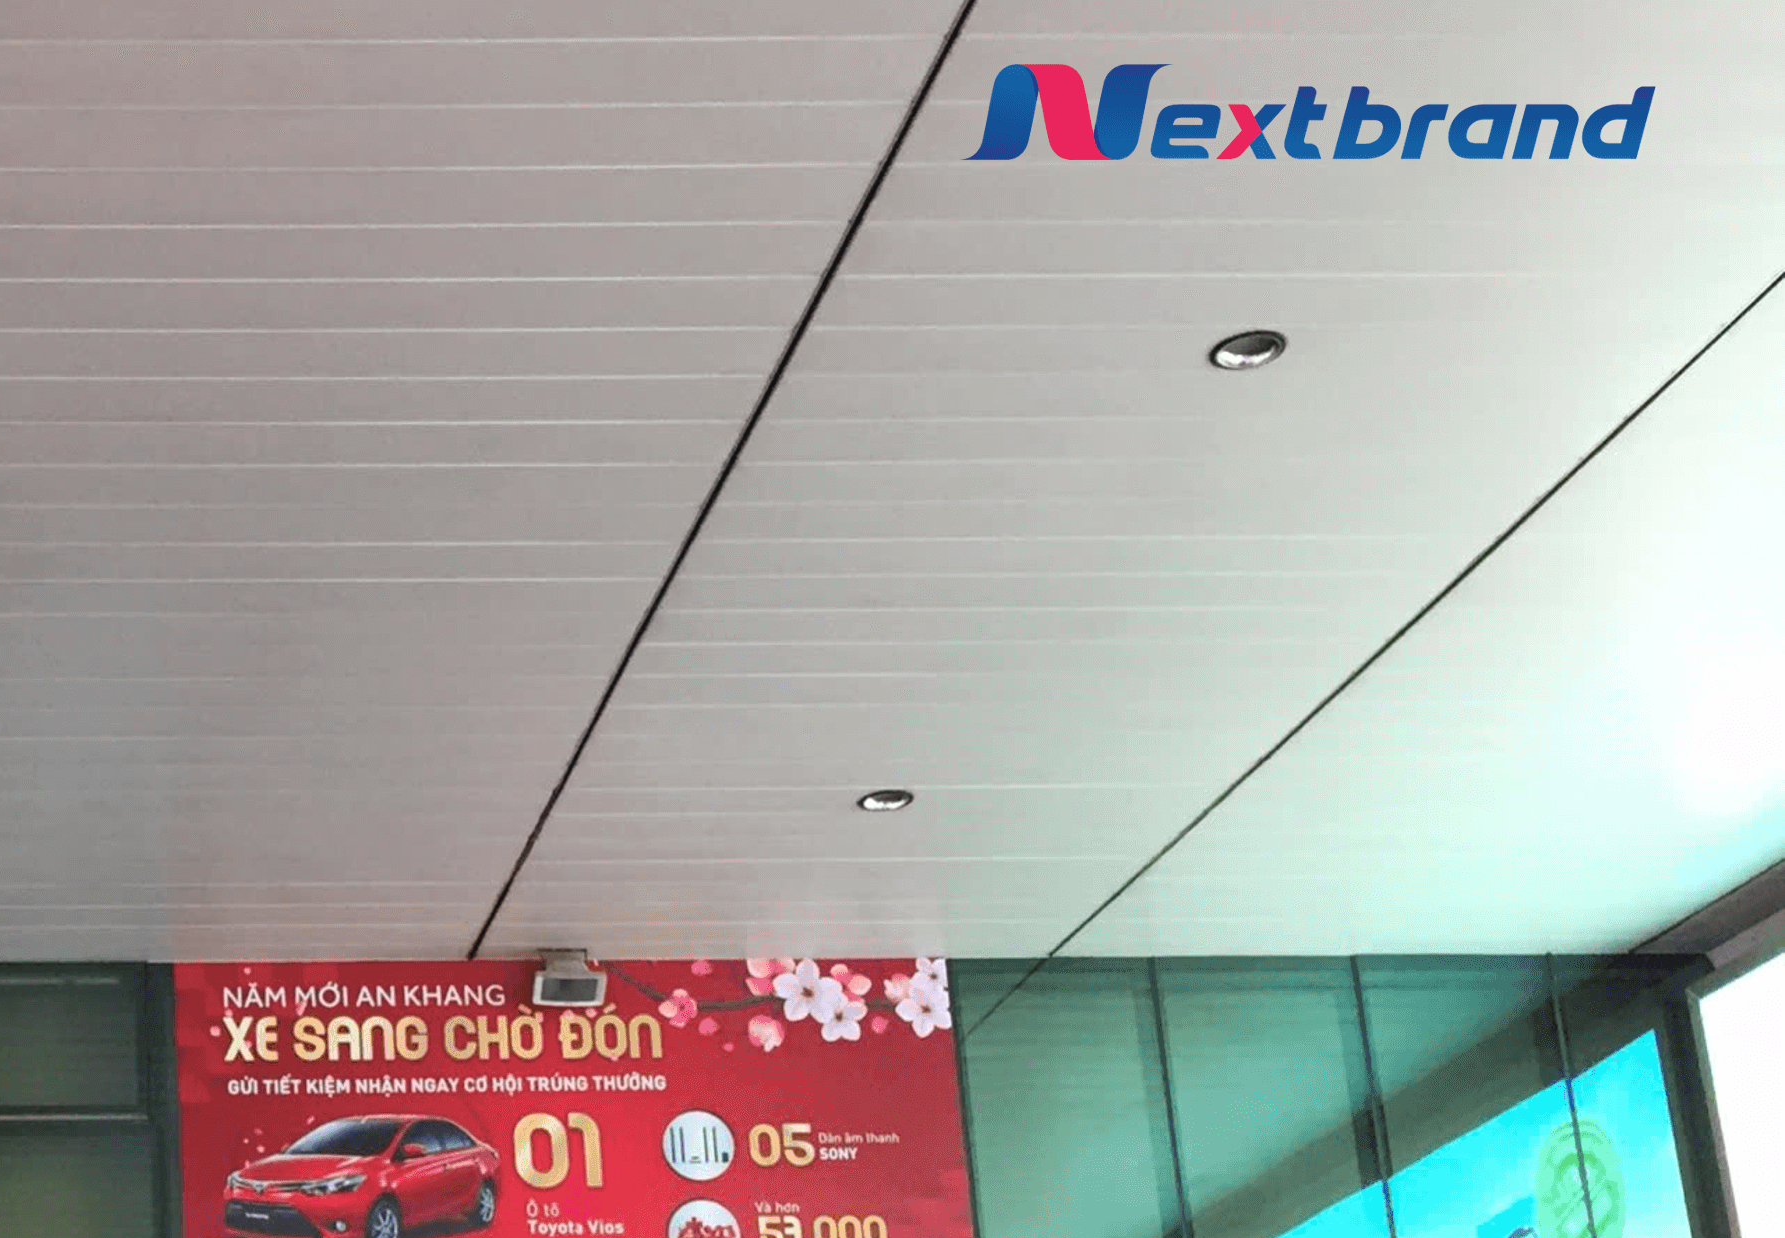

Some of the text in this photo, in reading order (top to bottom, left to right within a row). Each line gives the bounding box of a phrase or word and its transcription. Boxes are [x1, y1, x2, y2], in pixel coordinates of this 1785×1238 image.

[223, 981, 505, 1008] NĂM MỚI AN KHANG
[222, 1016, 279, 1061] XE
[293, 1015, 429, 1061] SANG
[444, 1003, 544, 1060] CHỜ
[228, 1075, 258, 1094] GỬI
[263, 1073, 301, 1094] TIẾT
[306, 1074, 350, 1097] KIỆM
[355, 1074, 406, 1097] NHẬN
[411, 1077, 459, 1093] NGAY
[464, 1076, 488, 1092] CƠ
[492, 1073, 522, 1096] HỘI
[526, 1072, 589, 1092] TRÚNG
[514, 1112, 603, 1189] 01
[748, 1122, 814, 1167] 05
[819, 1147, 858, 1160] SONY
[526, 1197, 560, 1218] Ô tô
[527, 1219, 625, 1237] Toyota Vios
